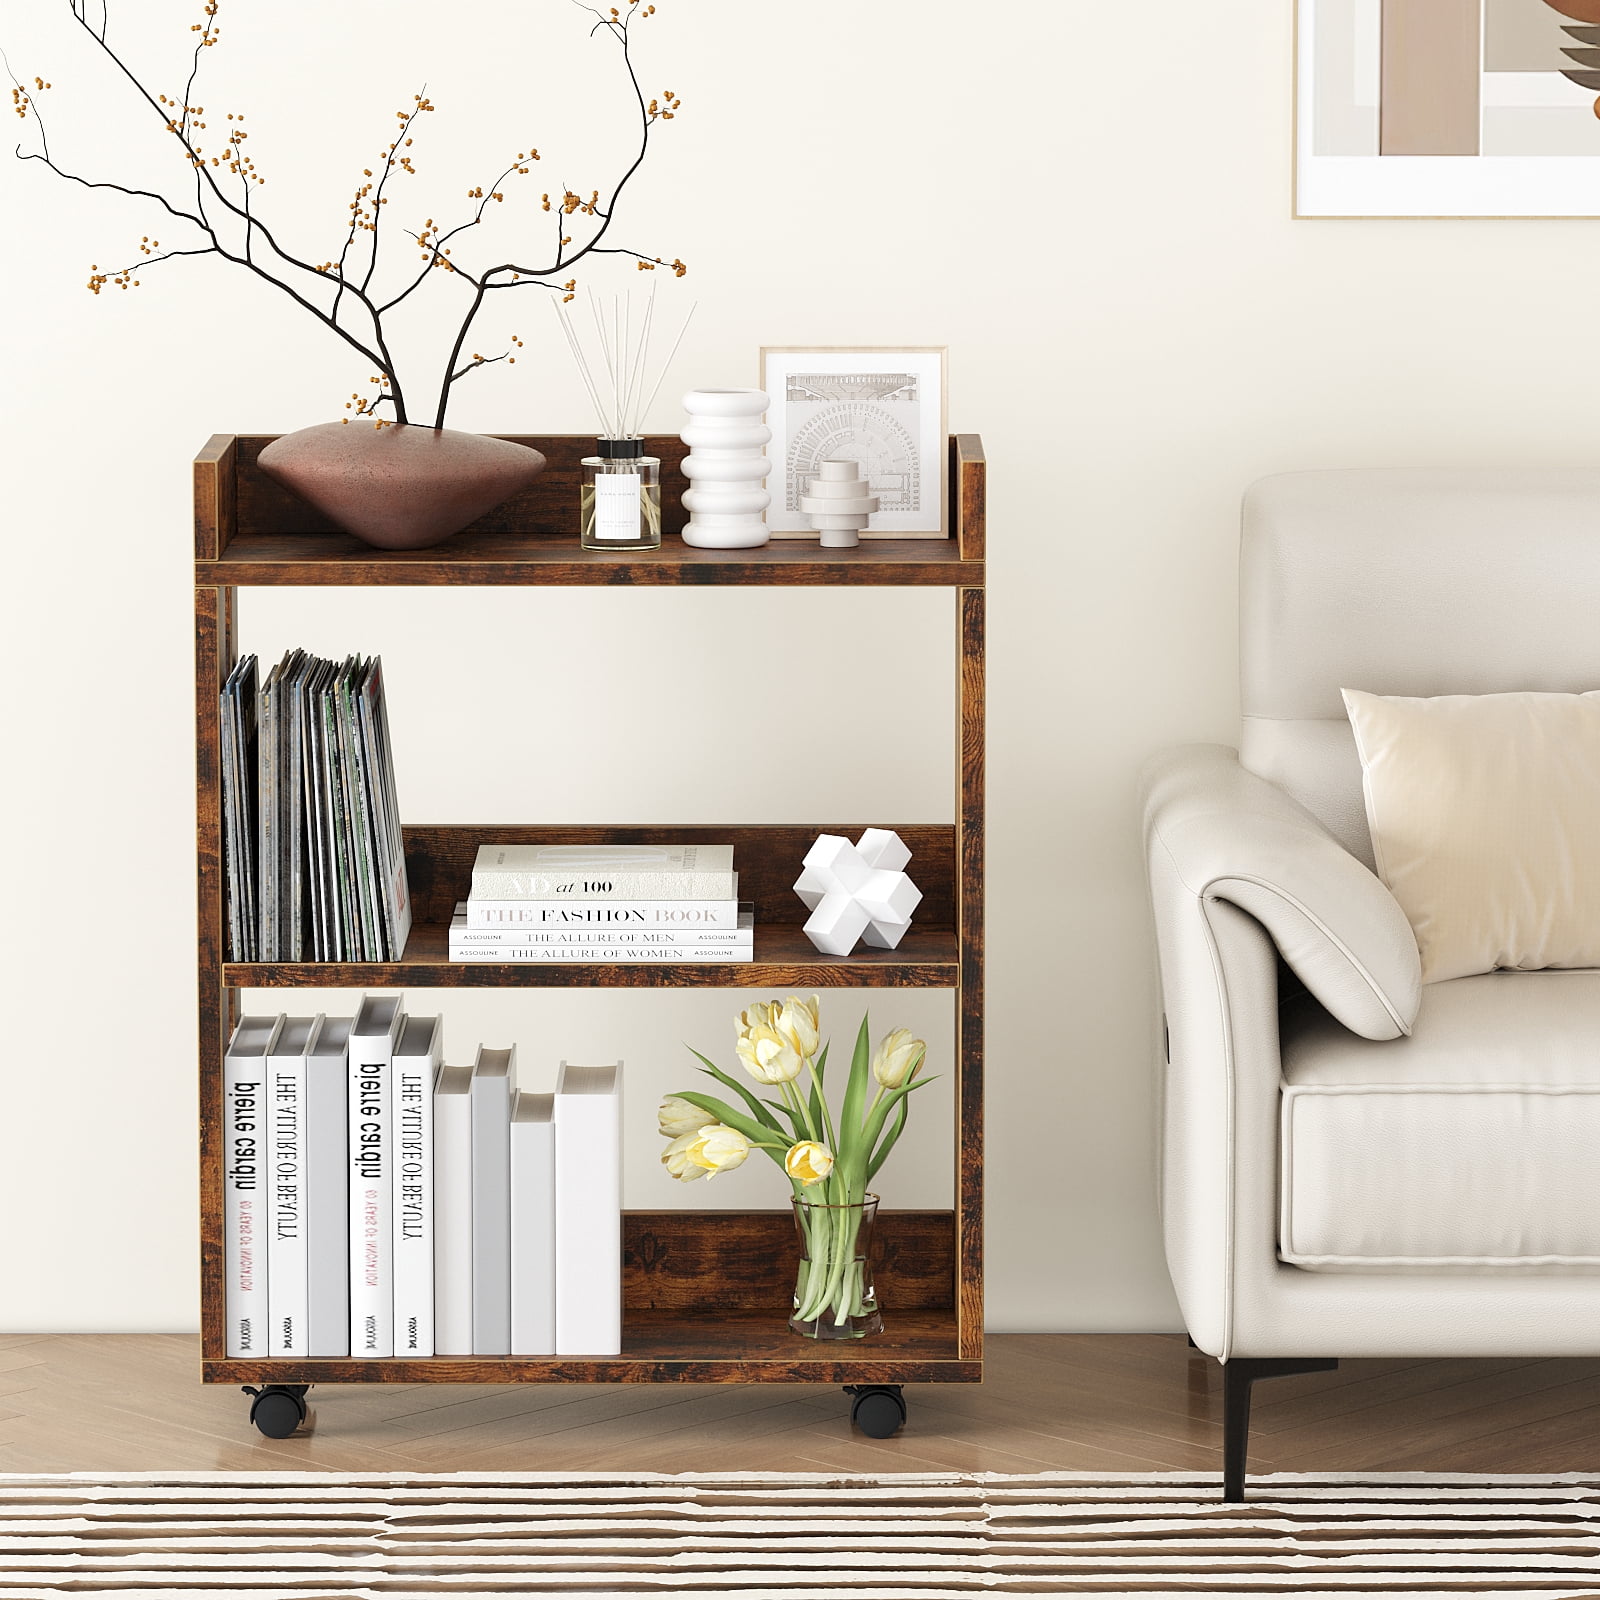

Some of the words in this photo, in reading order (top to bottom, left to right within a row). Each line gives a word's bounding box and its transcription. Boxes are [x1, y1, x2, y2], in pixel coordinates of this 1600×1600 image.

[556, 882, 575, 893] at
[583, 881, 613, 893] 100
[480, 909, 533, 922] THE
[541, 909, 646, 922] FASHION
[655, 909, 718, 922] BOOK
[527, 934, 553, 942] THE
[558, 934, 615, 942] ALLURE
[619, 934, 637, 942] OF
[643, 934, 675, 942] MEN
[509, 949, 538, 958] THE
[541, 949, 599, 958] ALLURE
[603, 949, 621, 958] OF
[627, 949, 683, 958] WOMEN
